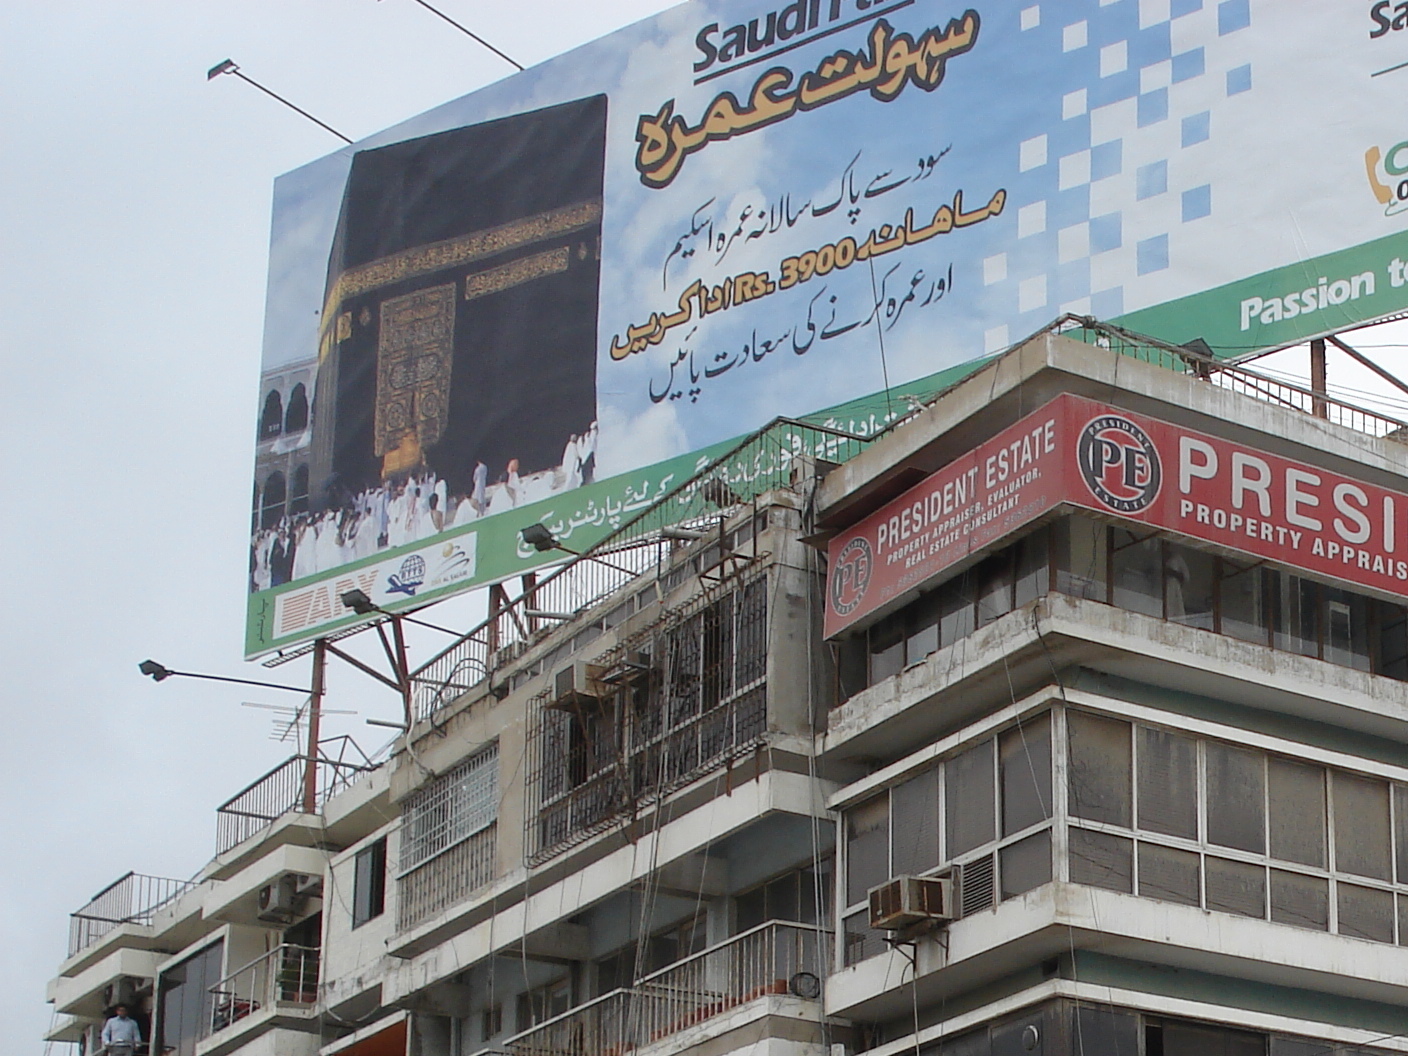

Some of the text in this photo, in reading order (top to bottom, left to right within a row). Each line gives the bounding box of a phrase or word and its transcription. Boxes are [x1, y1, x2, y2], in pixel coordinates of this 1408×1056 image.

[635, 9, 981, 189] سہولت عمرہ
[663, 142, 953, 291] سود سے پاک سالانہ عمرہ اسکیم
[733, 272, 775, 304] Rs.
[779, 236, 857, 291] 3900
[610, 279, 701, 361] کریں
[699, 276, 733, 319] ادا
[1239, 269, 1376, 332] Passion
[649, 262, 954, 403] اور عمرہ کرنے کی سعادت پائیں
[1088, 419, 1151, 449] PRESIDENT
[1092, 436, 1149, 492] PE
[877, 465, 979, 556] PRESIDENT
[986, 418, 1056, 490] ESTATE
[886, 533, 930, 566] PROPERTY
[933, 503, 985, 546] APPRAISER,
[987, 466, 1043, 512] EVALUATOR,
[1094, 486, 1148, 511] ESTATE
[905, 494, 1021, 569] REAL ESTATE CONSULTANT
[1180, 499, 1303, 551] PROPERTY
